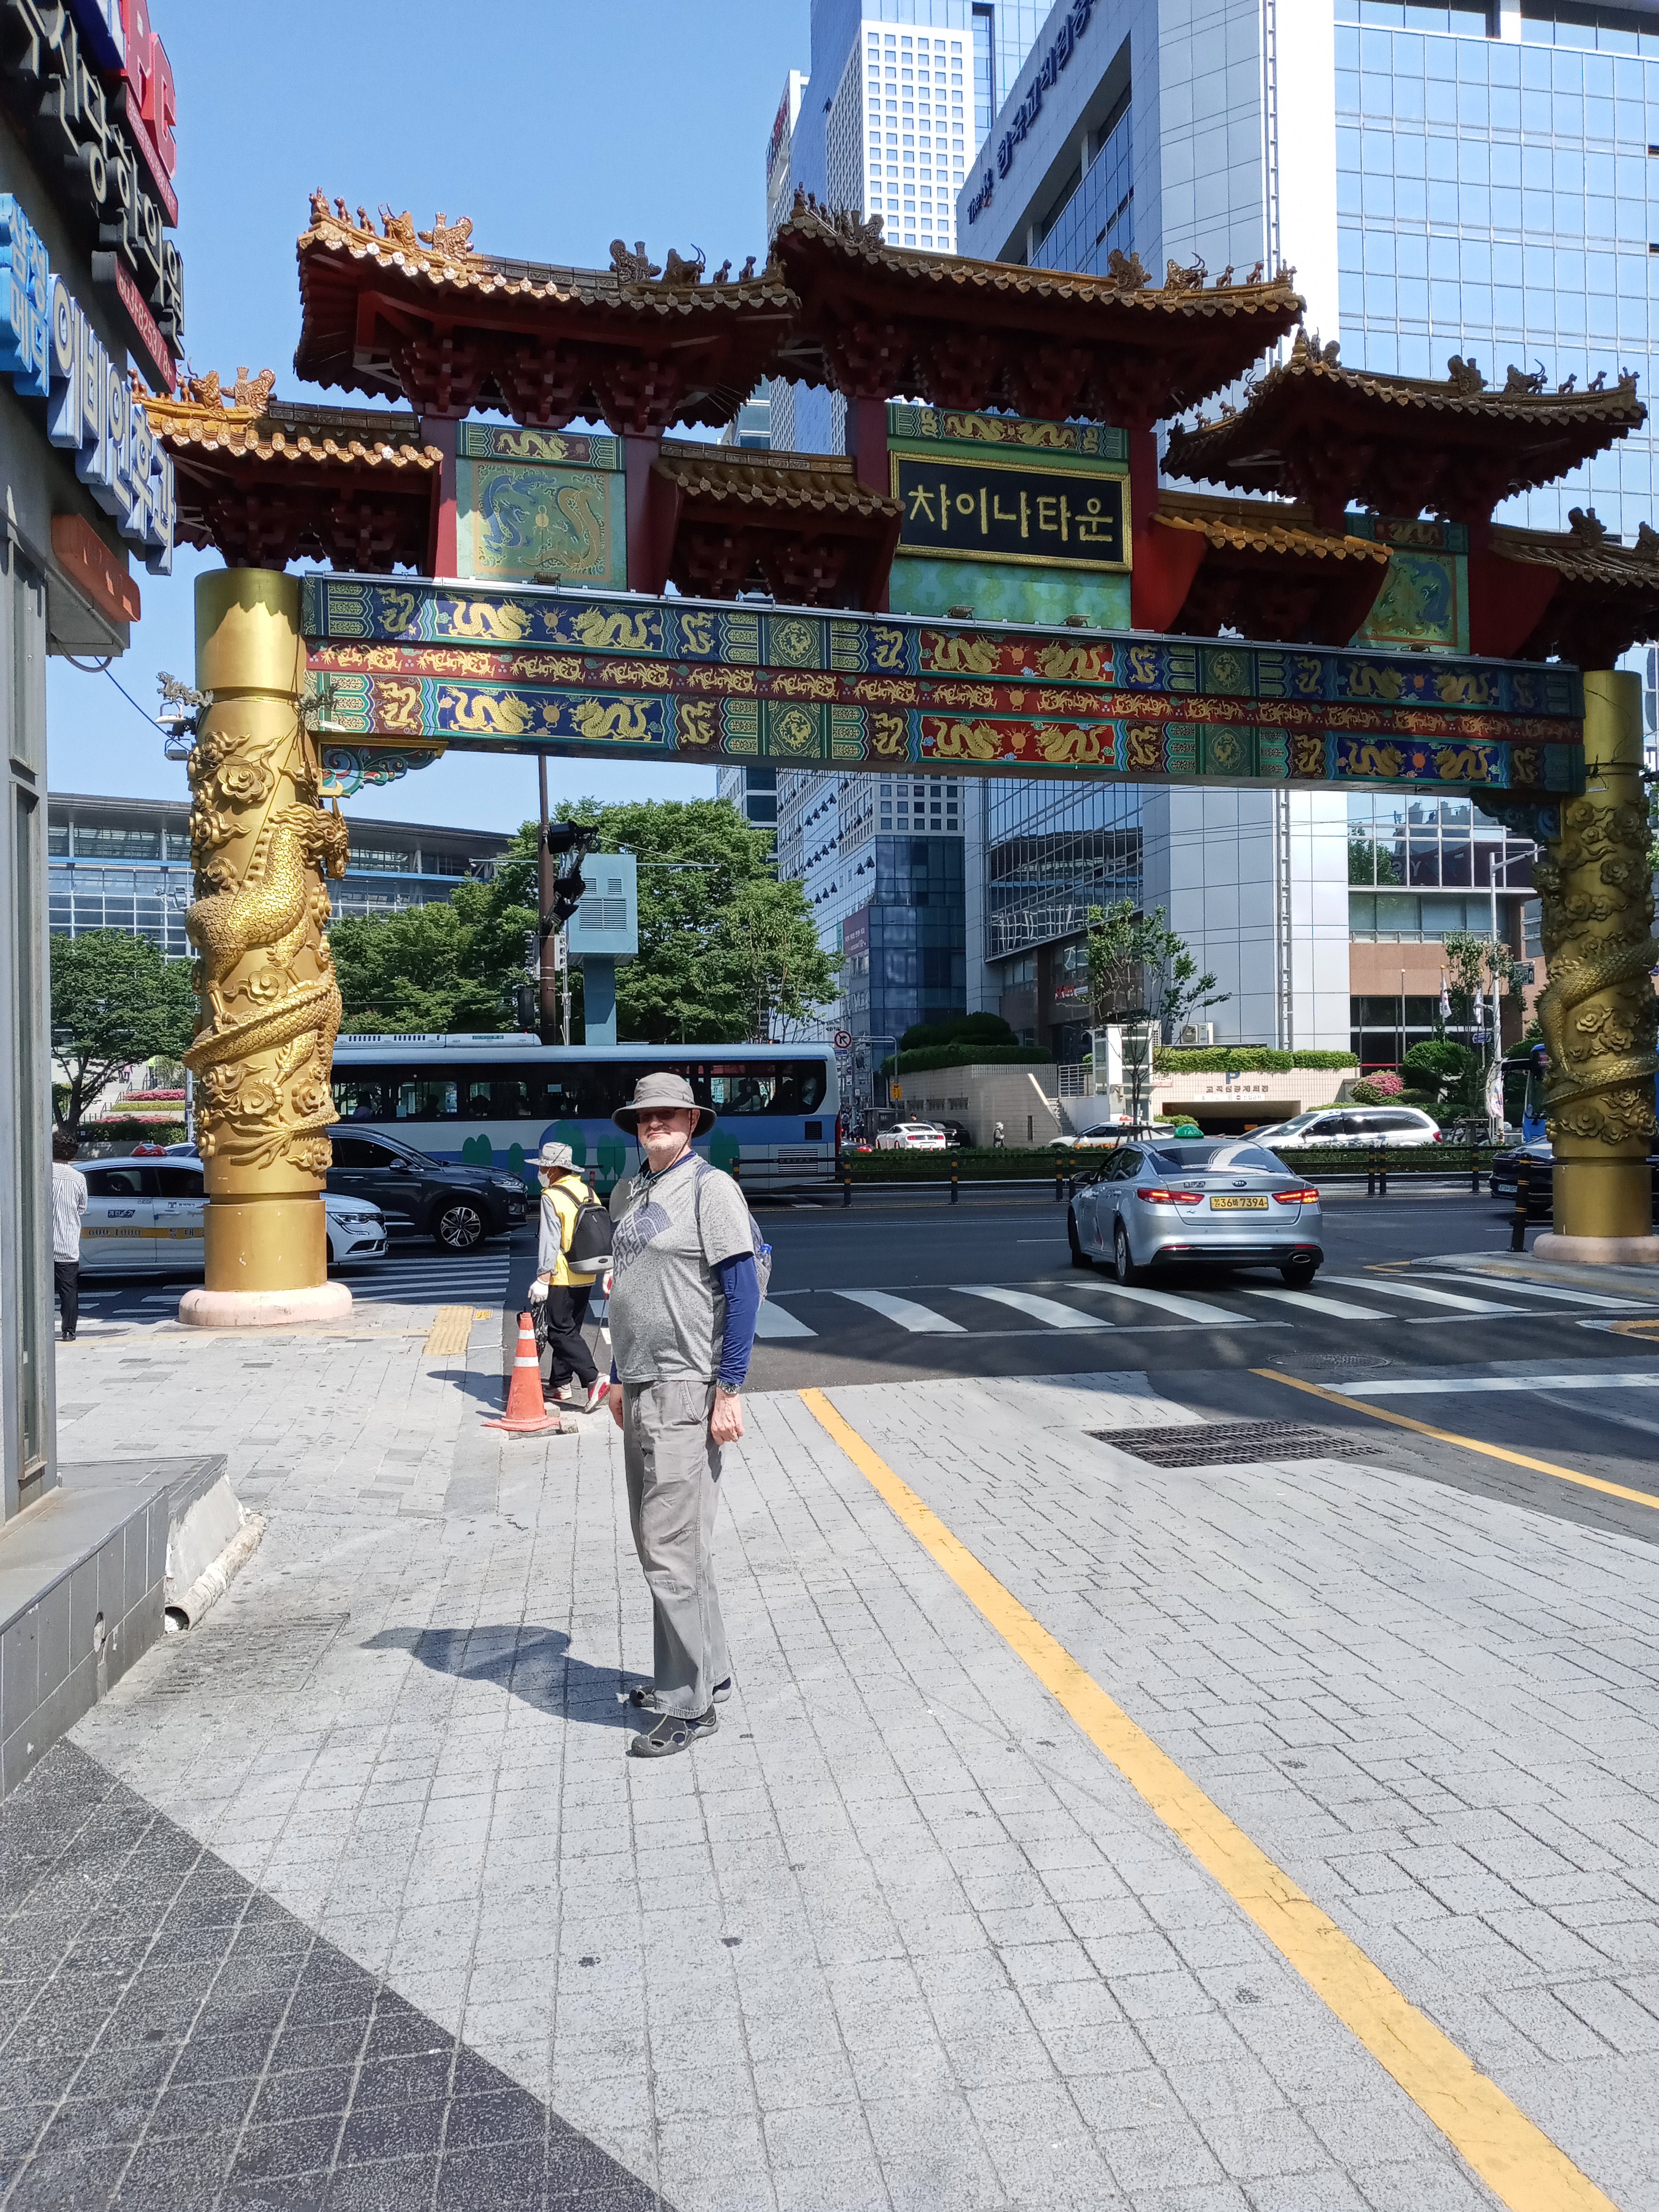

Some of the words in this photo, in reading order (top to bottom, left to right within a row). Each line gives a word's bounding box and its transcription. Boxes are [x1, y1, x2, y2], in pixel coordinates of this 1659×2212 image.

[997, 0, 1096, 179] 한국교직원공
[49, 274, 176, 572] 이비인후과
[908, 483, 1113, 542] 차이나타운
[1226, 1071, 1241, 1084] P
[1240, 1198, 1264, 1207] 7394
